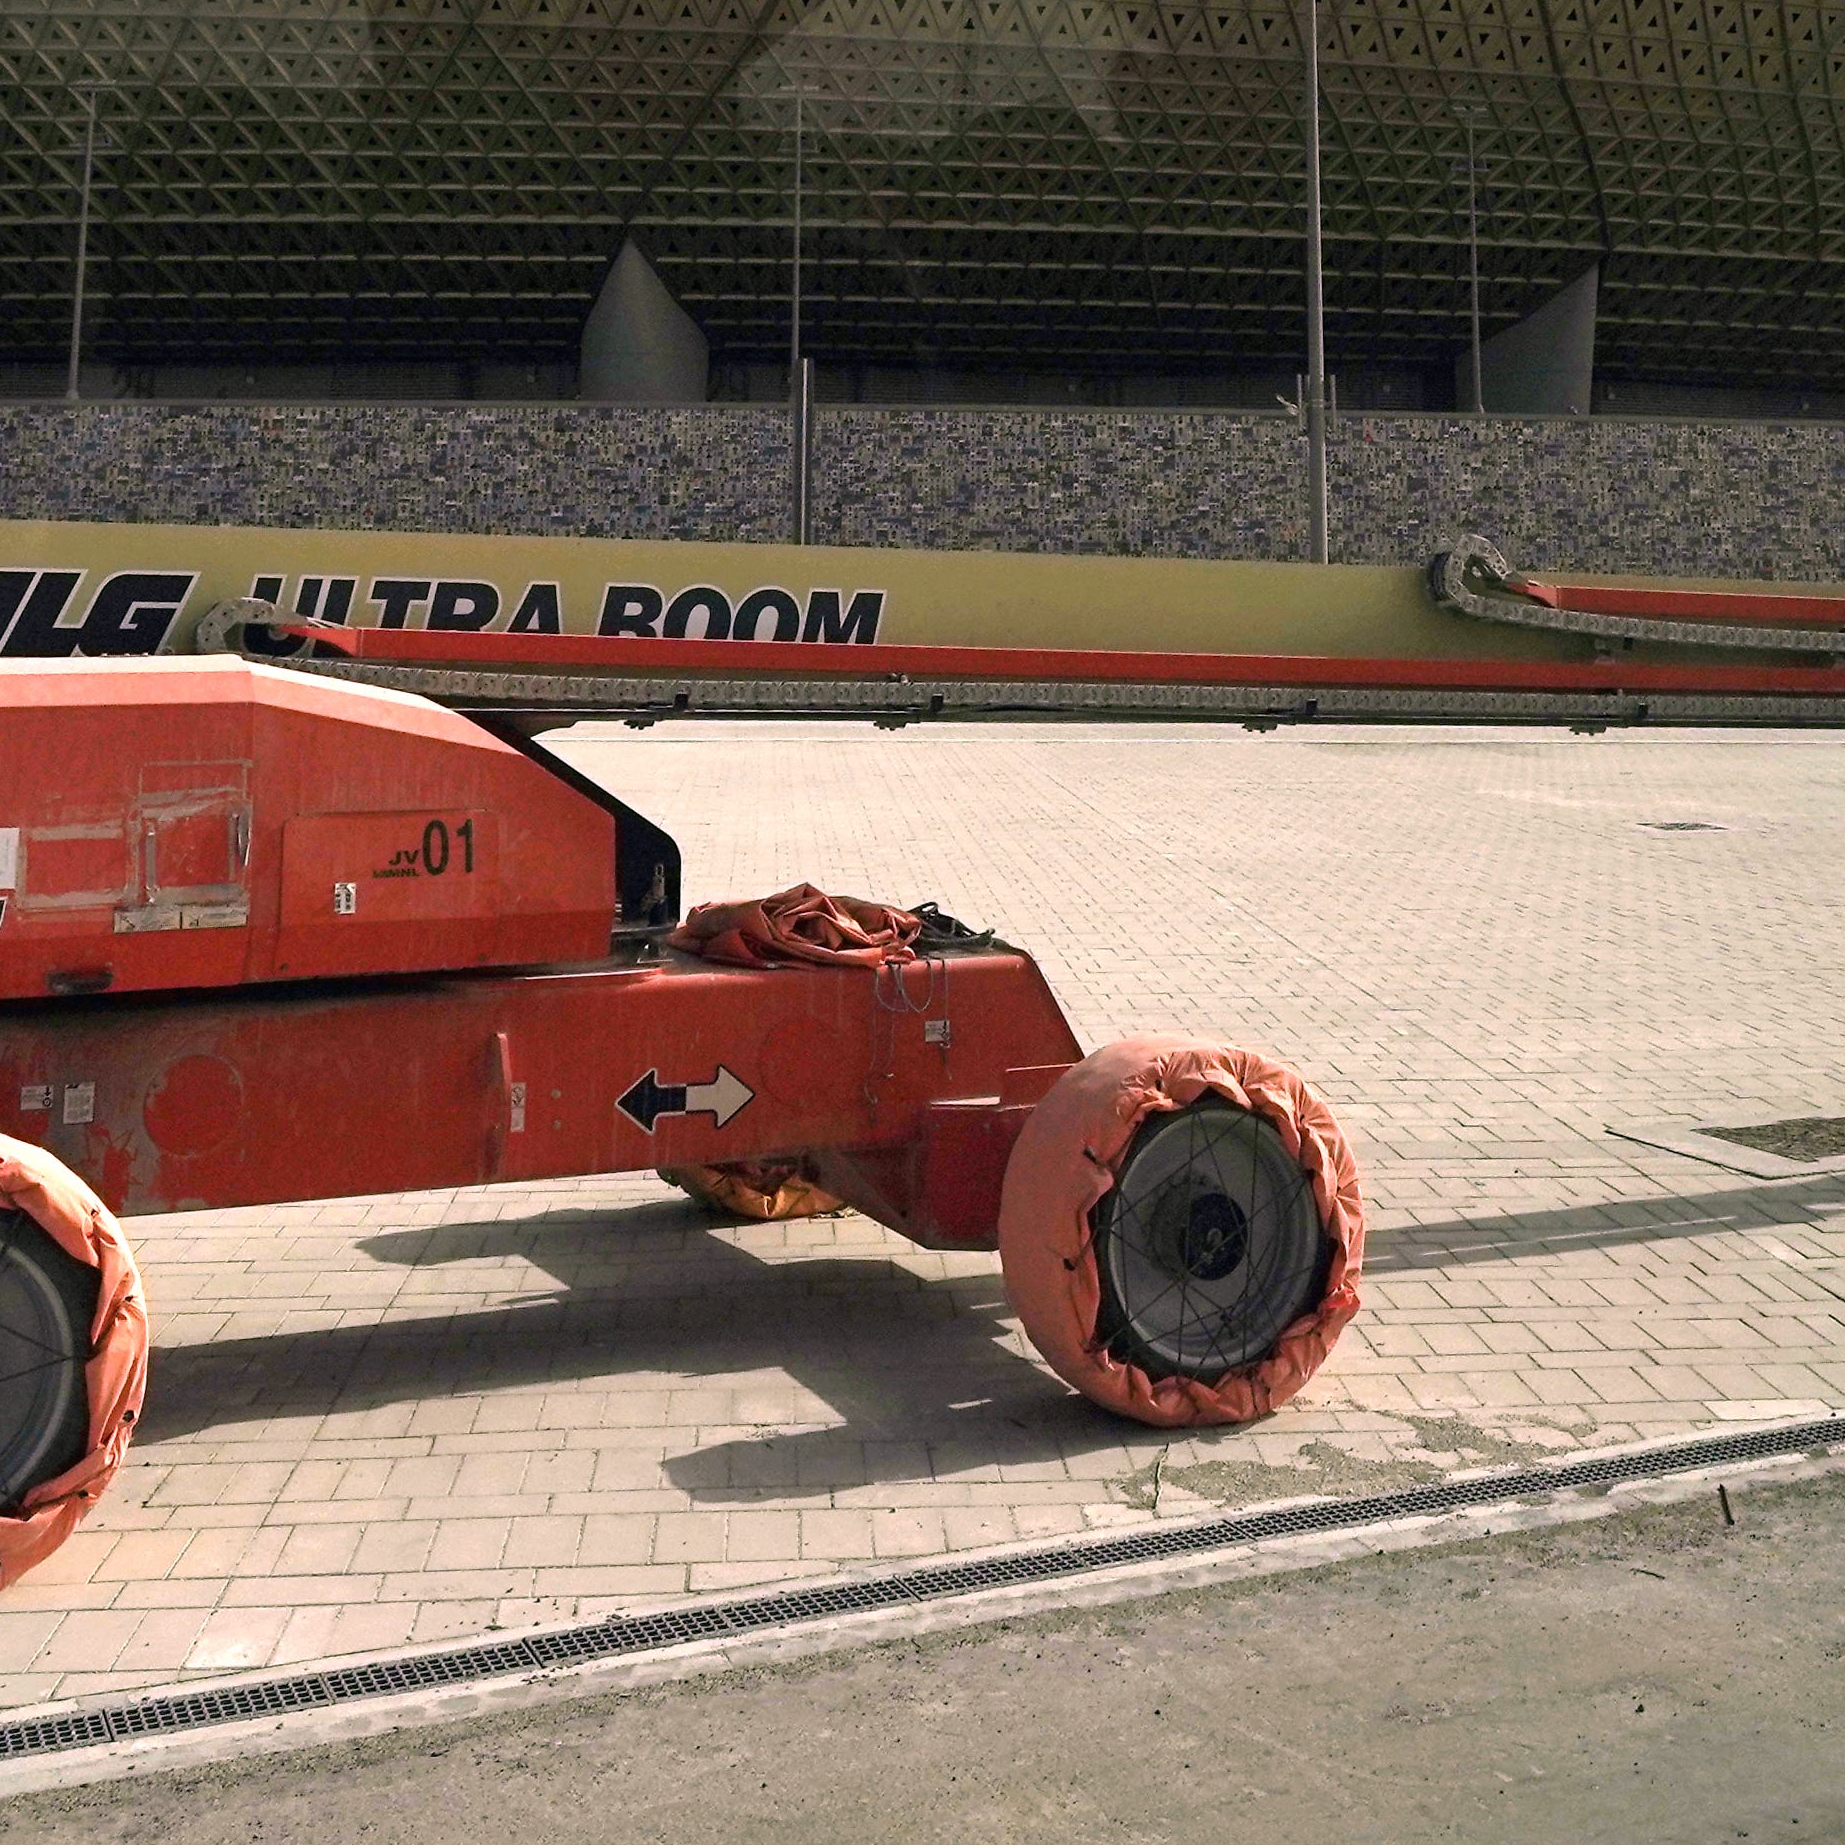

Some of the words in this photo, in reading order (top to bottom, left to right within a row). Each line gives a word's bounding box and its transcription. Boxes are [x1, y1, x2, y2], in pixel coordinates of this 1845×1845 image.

[596, 582, 888, 646] BOOM
[389, 850, 419, 866] JV
[422, 818, 473, 876] 01
